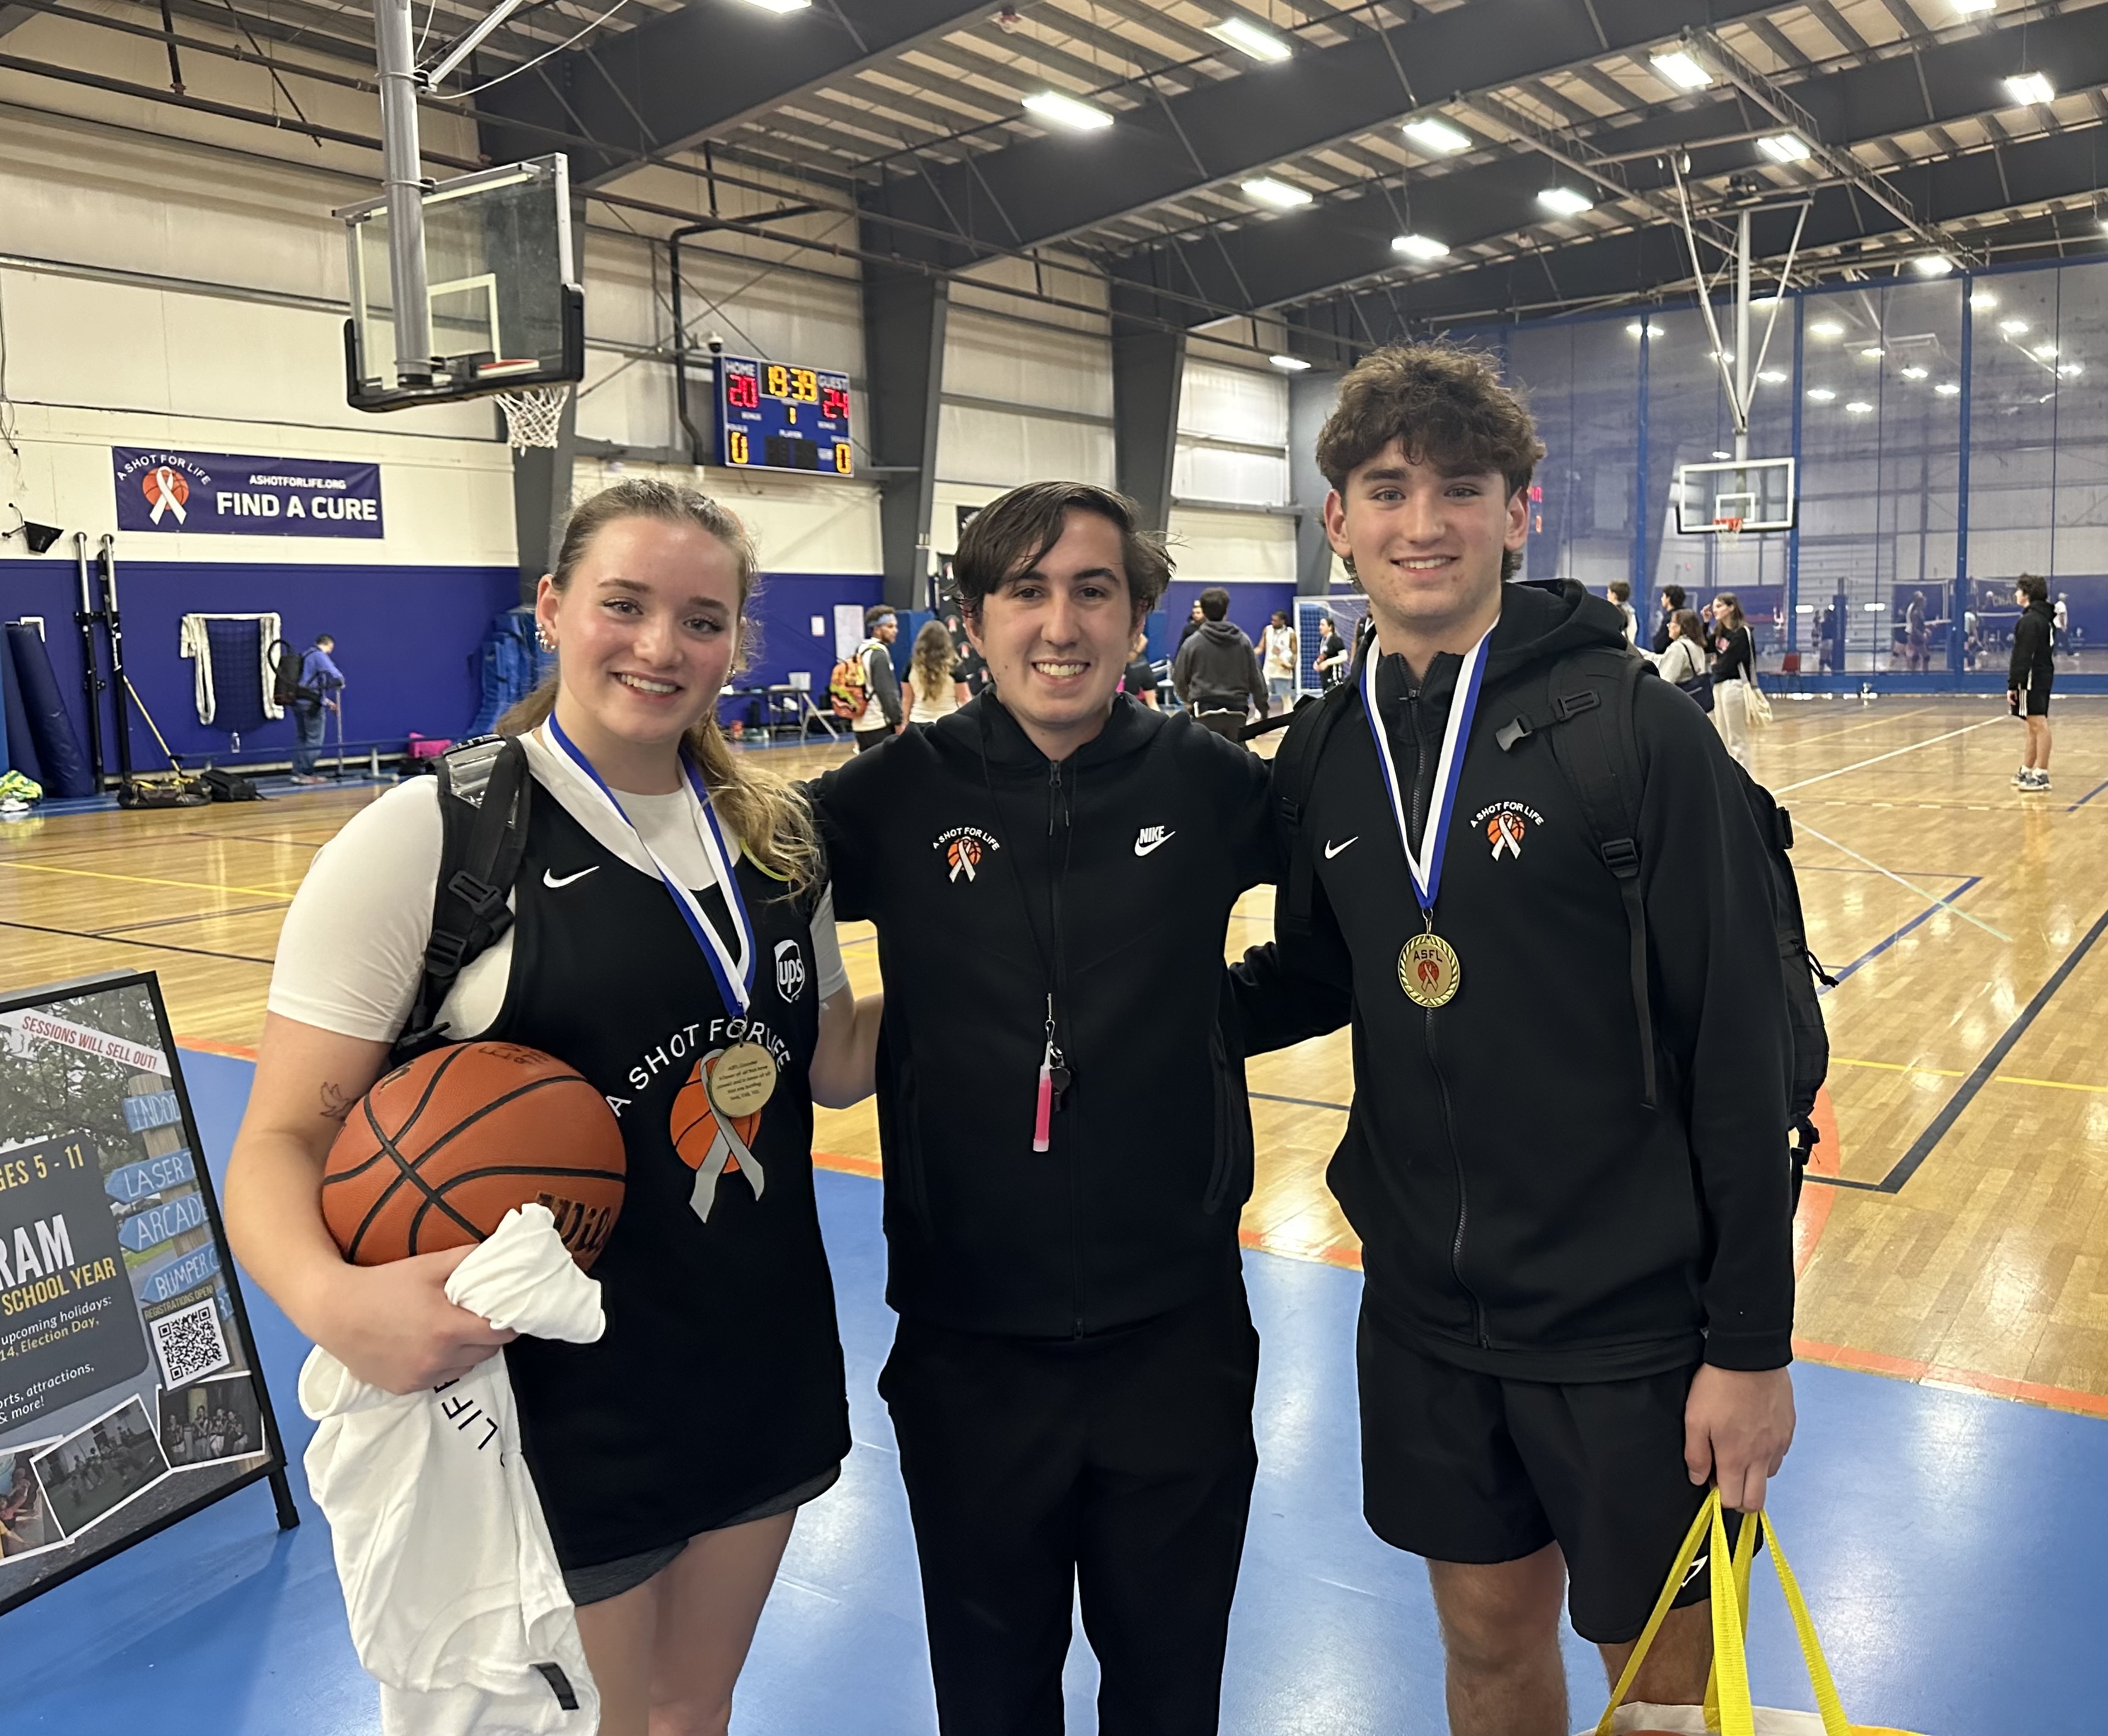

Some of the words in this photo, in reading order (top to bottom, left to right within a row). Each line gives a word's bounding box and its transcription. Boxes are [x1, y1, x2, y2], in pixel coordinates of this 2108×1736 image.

[726, 360, 755, 376] HOME
[729, 374, 758, 408] 20
[822, 388, 849, 419] 24
[117, 471, 127, 481] A
[124, 454, 156, 473] SHOT
[160, 454, 186, 468] FOR
[187, 463, 211, 485] LIFE
[836, 443, 851, 473] 0
[250, 475, 346, 490] ASHOTFORLIFE.ORG
[217, 492, 280, 517] FIND
[286, 495, 306, 518] A
[311, 496, 378, 521] CURE
[1470, 819, 1478, 828] A
[1476, 802, 1502, 820] SHOT
[1503, 801, 1524, 812] FOR
[1524, 806, 1544, 826] LIFE
[939, 827, 963, 843] SHOT
[964, 827, 982, 837] FOR
[982, 832, 1000, 851] LIFE
[1139, 825, 1165, 844] NIKE
[1413, 949, 1442, 963] ASFL
[779, 958, 803, 993] ups
[22, 1016, 78, 1044] SESSIONS
[78, 1033, 103, 1053] WILL
[106, 1043, 130, 1062] SELL
[133, 1051, 158, 1070] OUT!
[605, 1094, 632, 1118] A
[628, 1023, 701, 1091] SHOT
[709, 1018, 765, 1044] FOR
[33, 1154, 47, 1179] 5
[65, 1143, 84, 1169] 11
[124, 1157, 185, 1197] LASER
[1, 1275, 70, 1316] SCHOOL
[70, 1257, 117, 1289] YEAR
[154, 1253, 209, 1300] BUMPER
[1, 1316, 57, 1345] upcoming
[59, 1296, 112, 1322] holidays:
[144, 1292, 195, 1320] REGISTRATIONS
[20, 1327, 69, 1353] Election
[71, 1317, 100, 1333] Day,
[11, 1395, 44, 1419] more!
